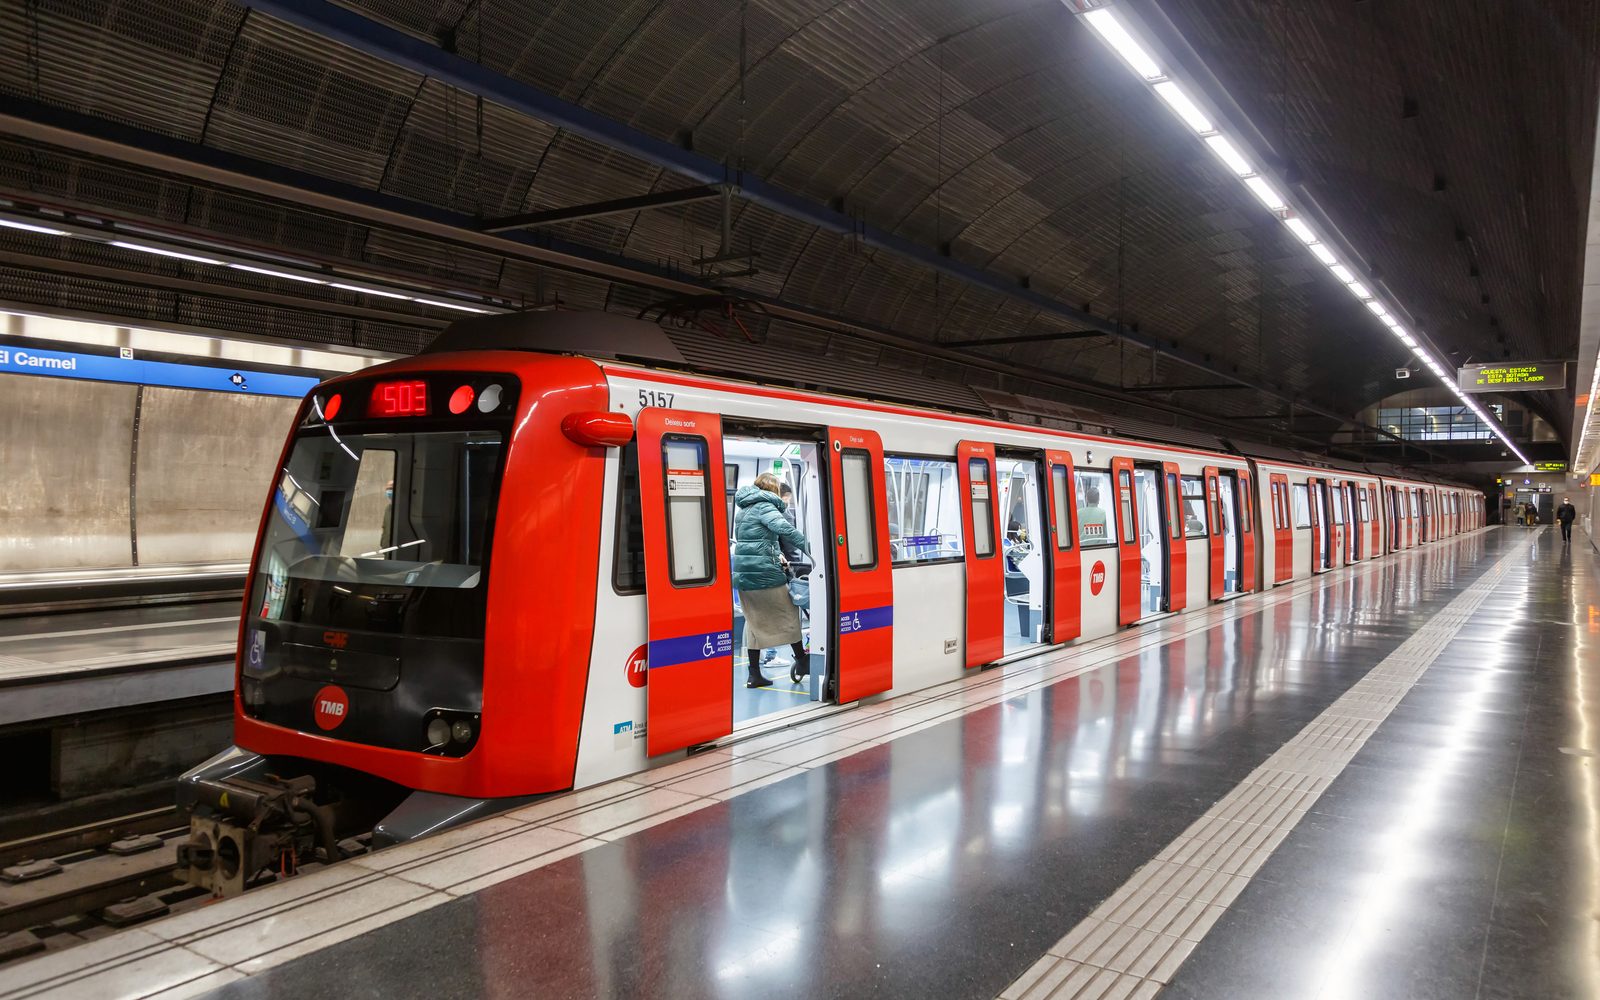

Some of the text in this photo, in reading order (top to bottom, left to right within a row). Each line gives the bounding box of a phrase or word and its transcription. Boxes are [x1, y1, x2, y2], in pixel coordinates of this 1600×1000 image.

[14, 352, 76, 370] Carmel
[233, 375, 242, 384] M
[384, 384, 426, 413] 503
[638, 389, 674, 409] 5157
[1092, 572, 1104, 584] TMB
[633, 659, 648, 674] TM
[320, 700, 345, 716] TMB
[619, 724, 631, 734] ATM
